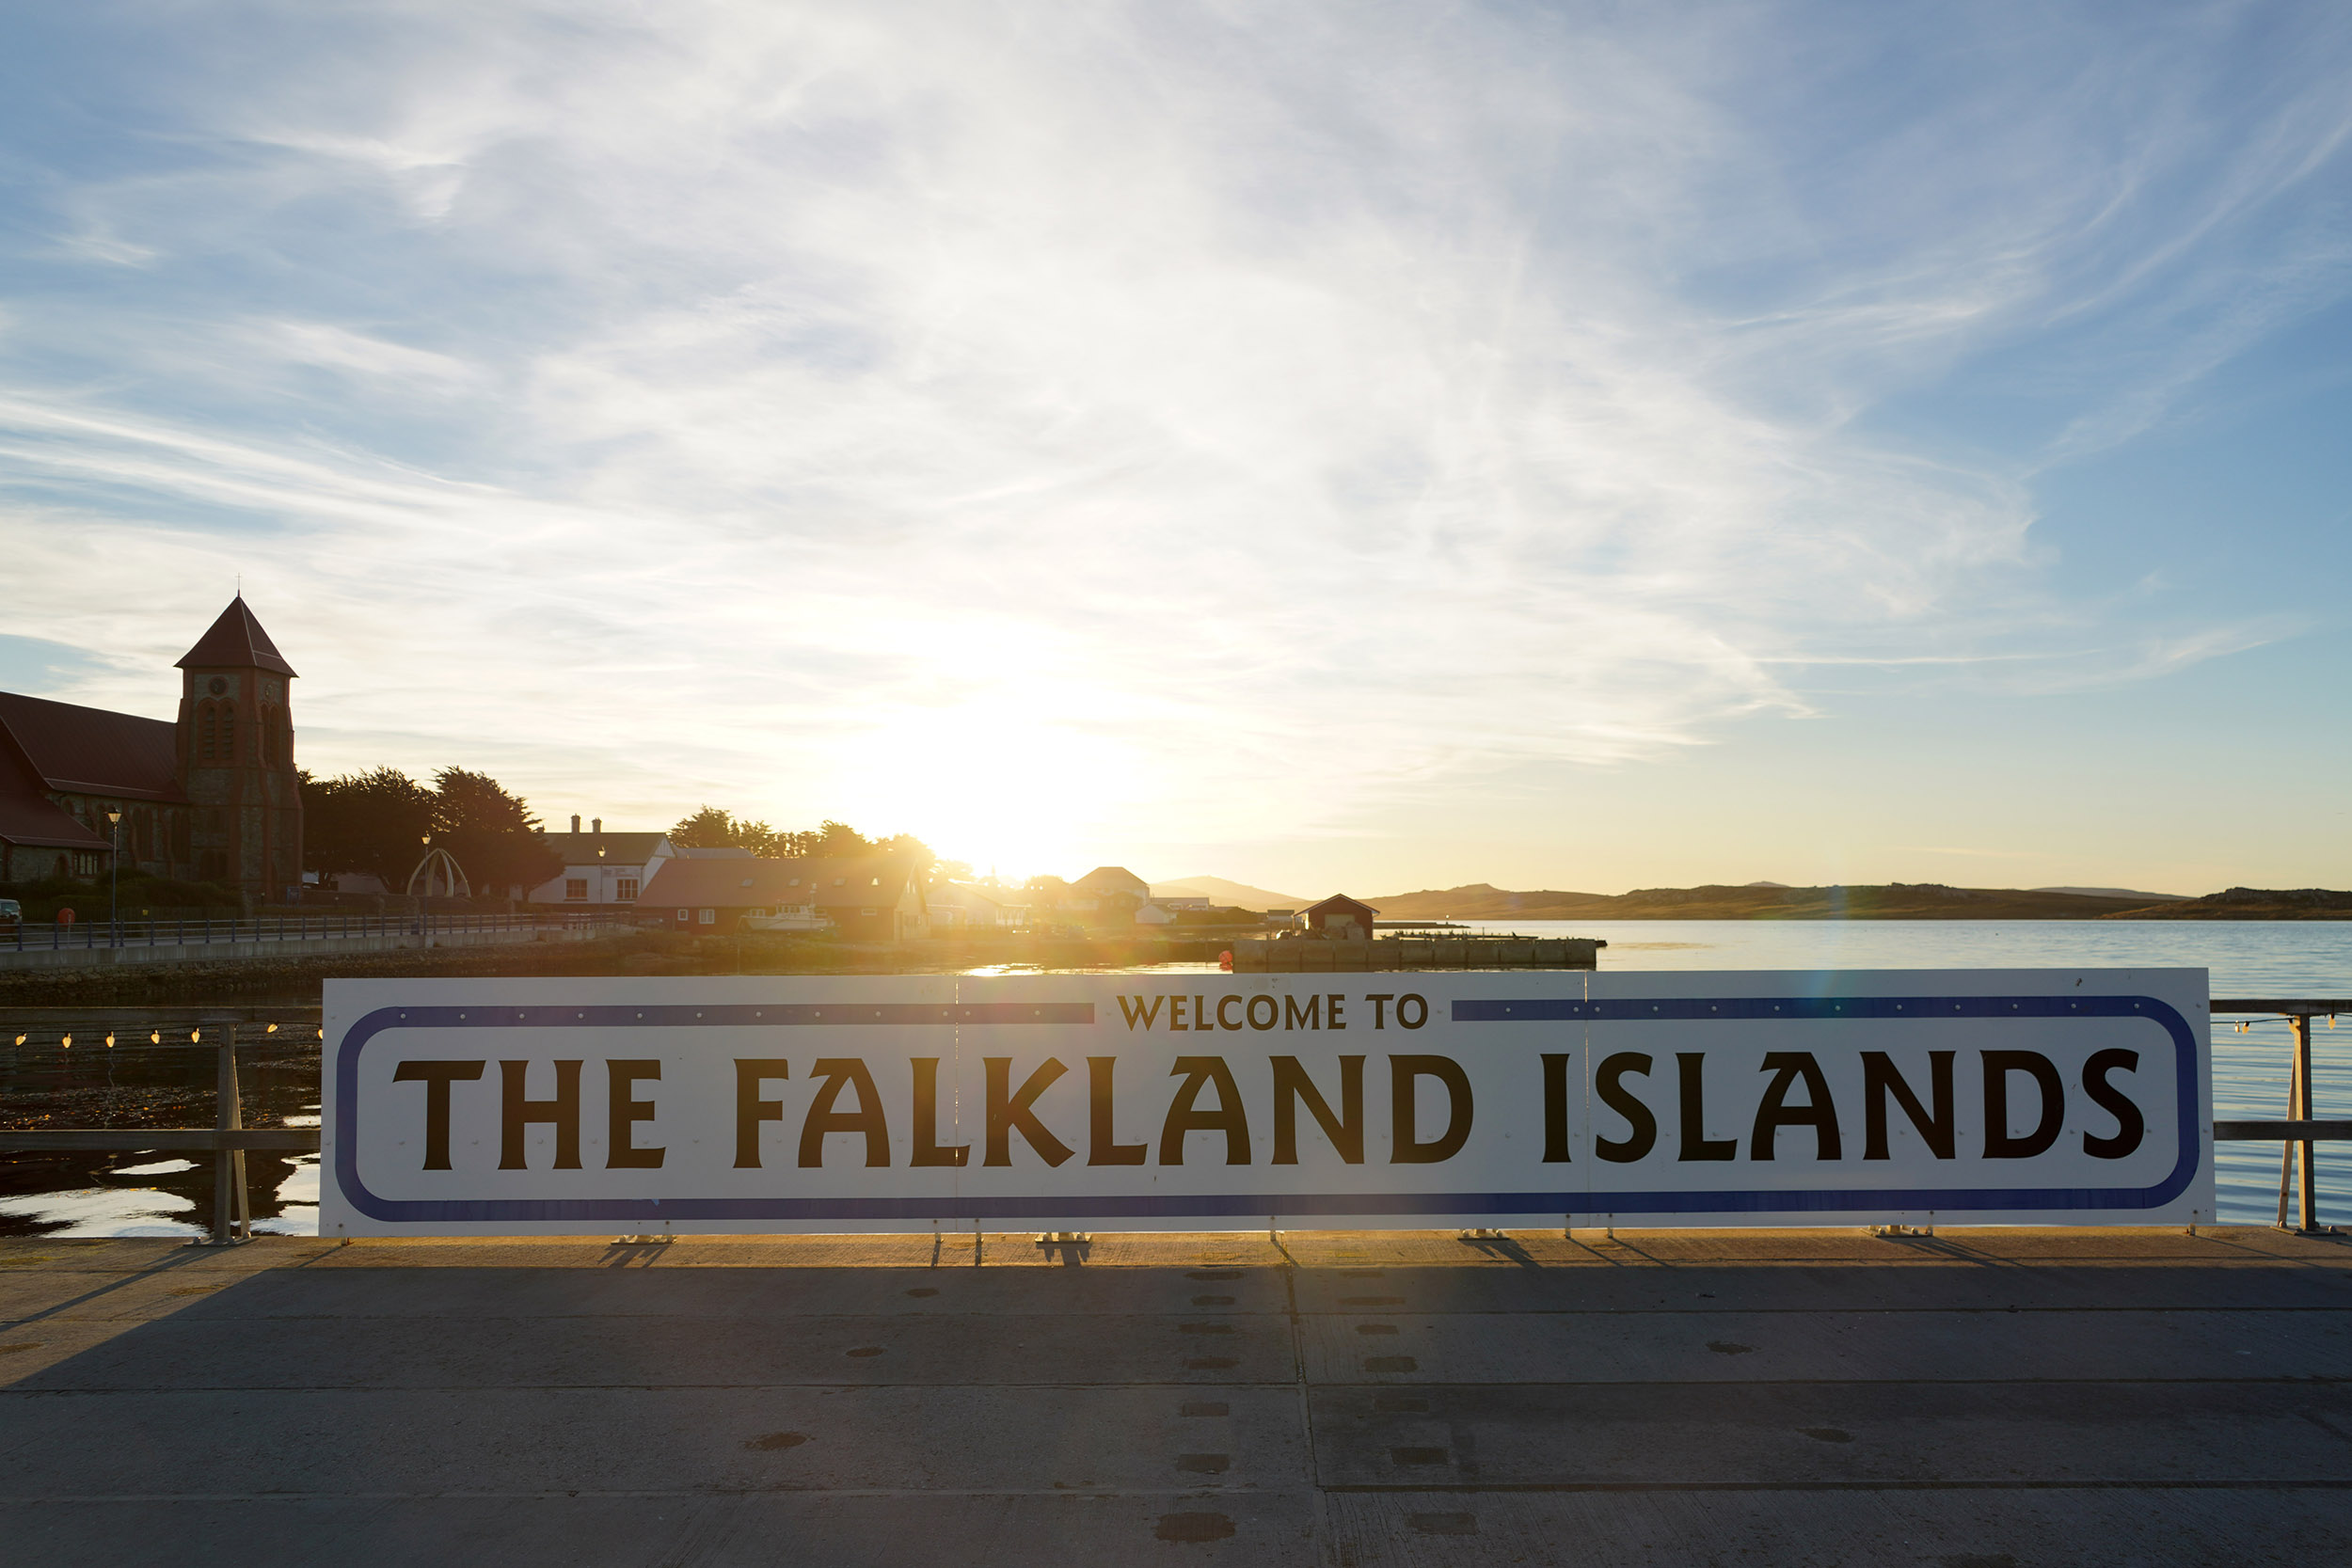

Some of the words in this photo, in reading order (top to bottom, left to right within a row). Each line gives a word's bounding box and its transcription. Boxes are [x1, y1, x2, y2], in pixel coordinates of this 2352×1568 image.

[1116, 993, 1347, 1032] WELCOME
[1365, 992, 1429, 1031] TO
[392, 1059, 666, 1171] THE
[732, 1054, 1474, 1169] FALKLAND
[1539, 1048, 2146, 1164] ISLANDS
